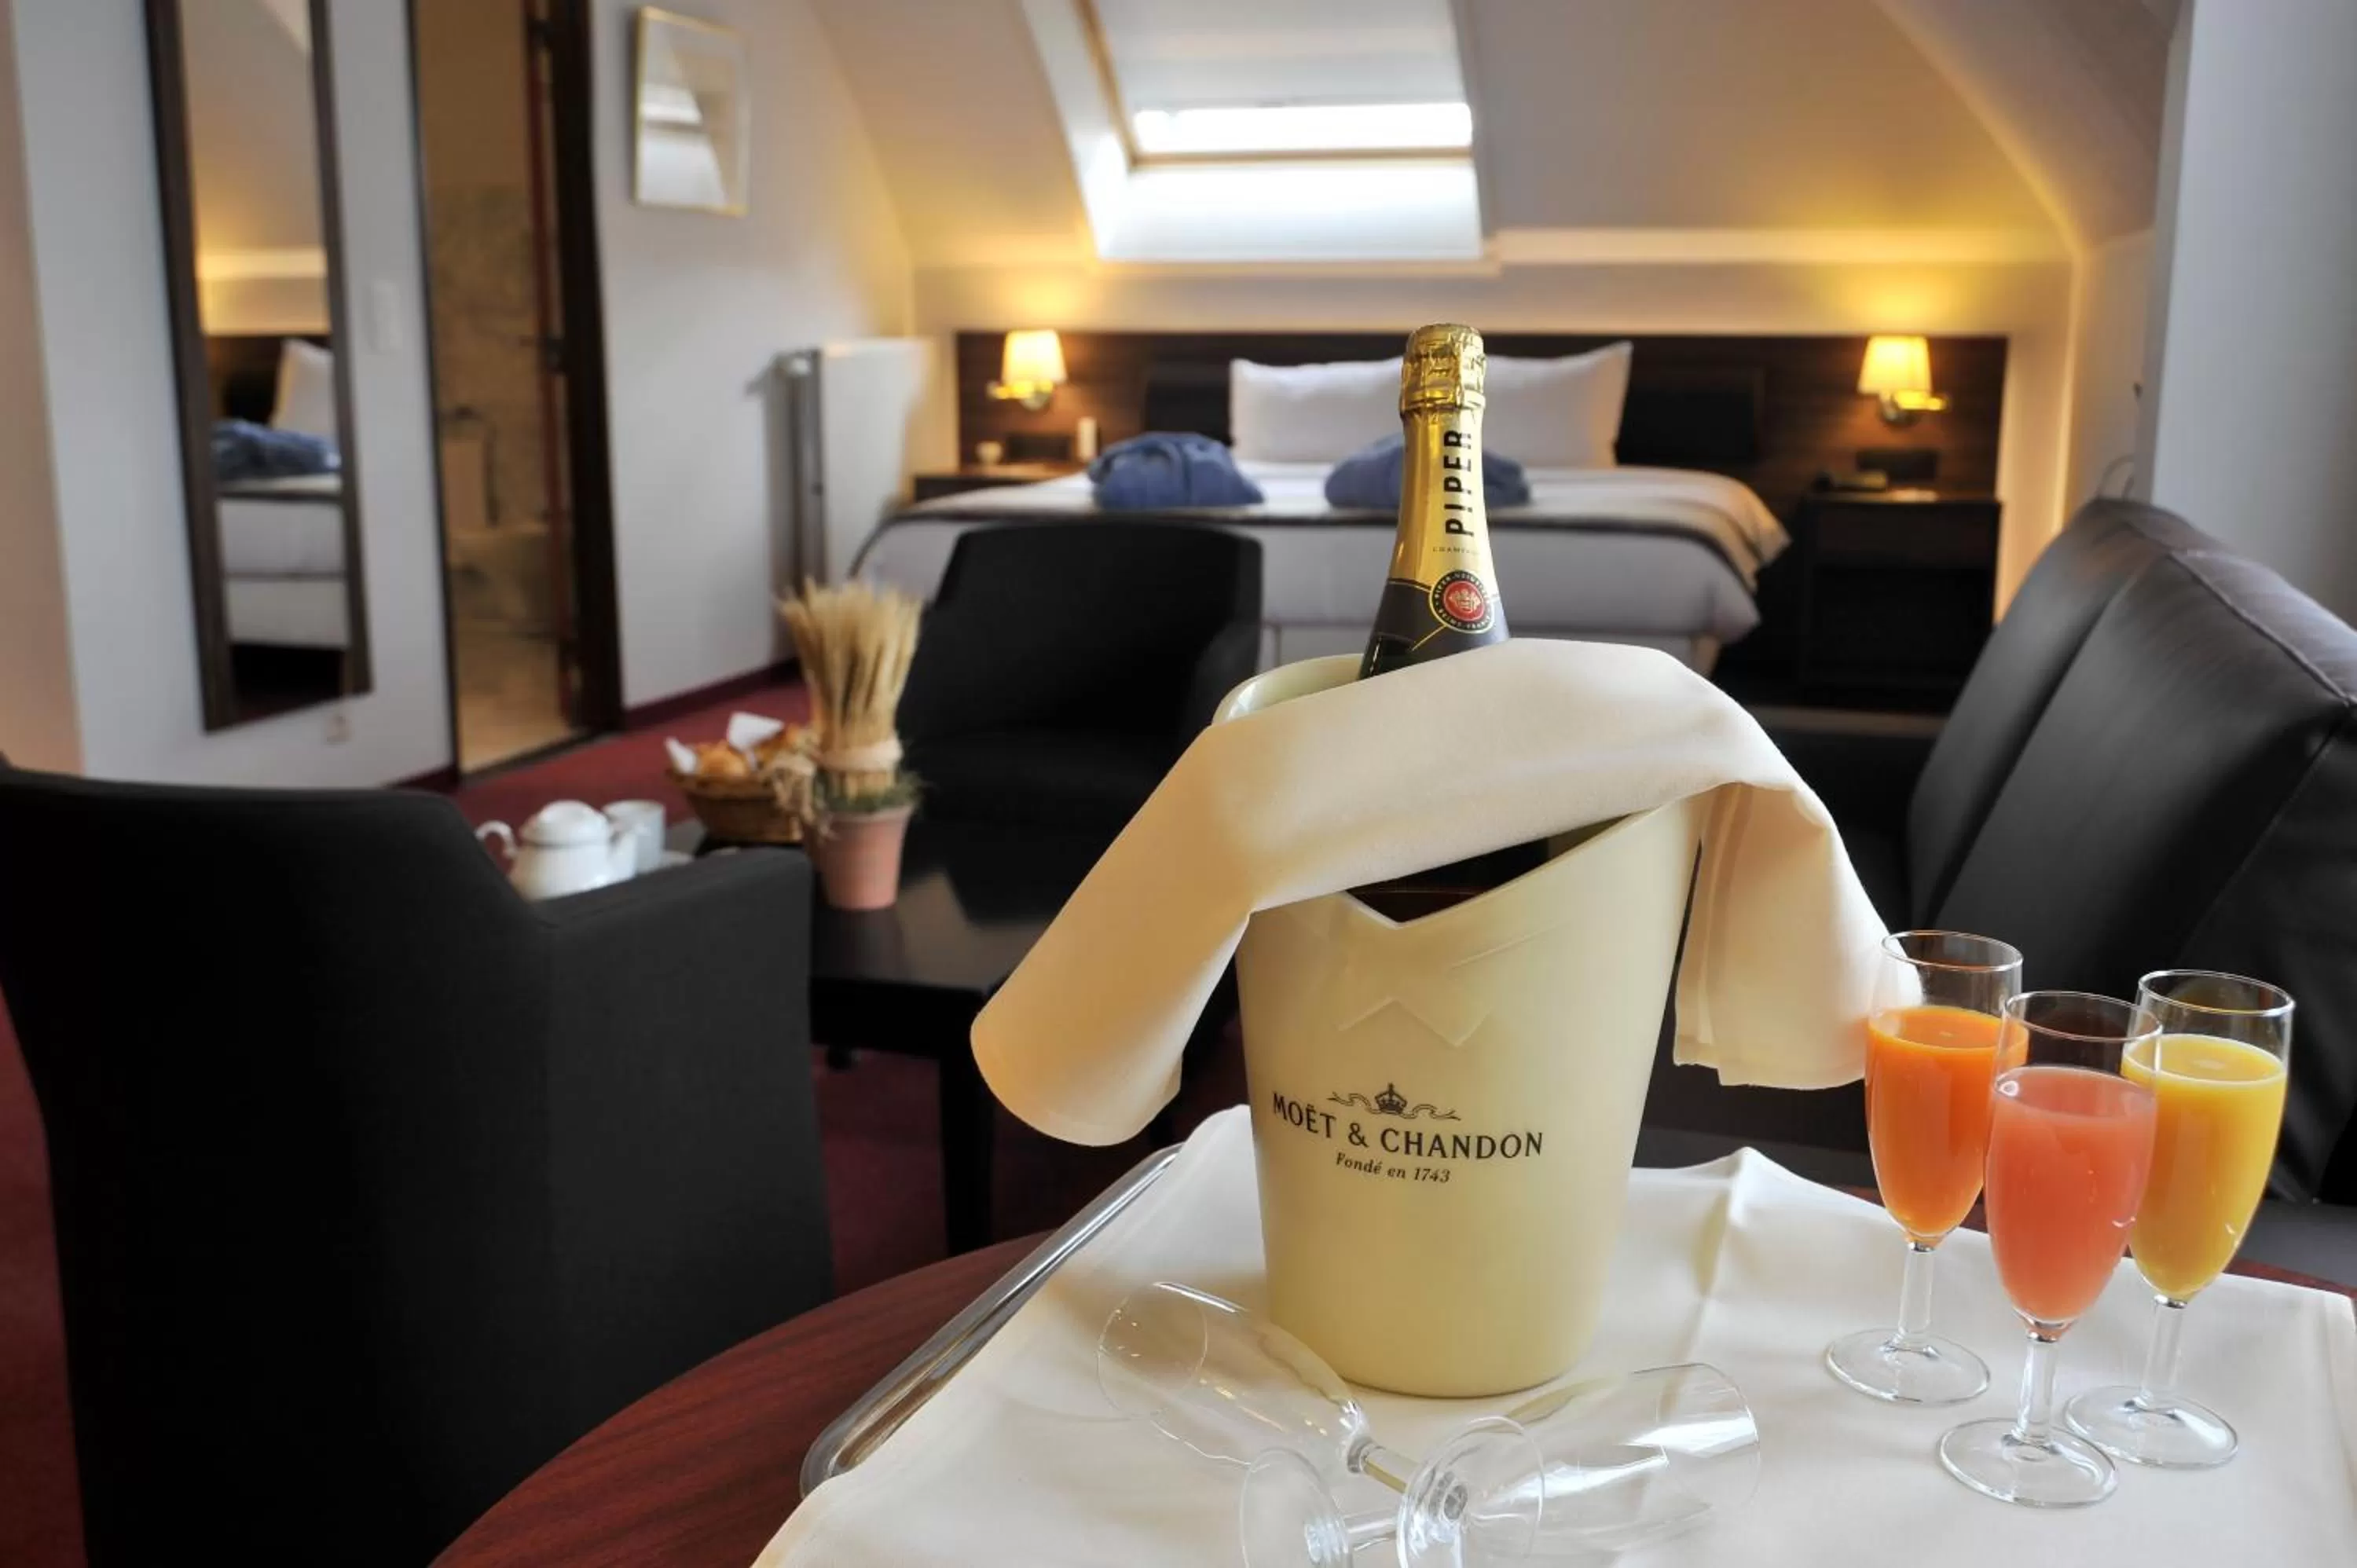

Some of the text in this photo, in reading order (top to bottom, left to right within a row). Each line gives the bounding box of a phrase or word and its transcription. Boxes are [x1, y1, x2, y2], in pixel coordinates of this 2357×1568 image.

[1443, 430, 1474, 537] PIPER
[1273, 1092, 1544, 1160] MOËT & CHANDON
[1335, 1151, 1452, 1184] Fondé en 1743
